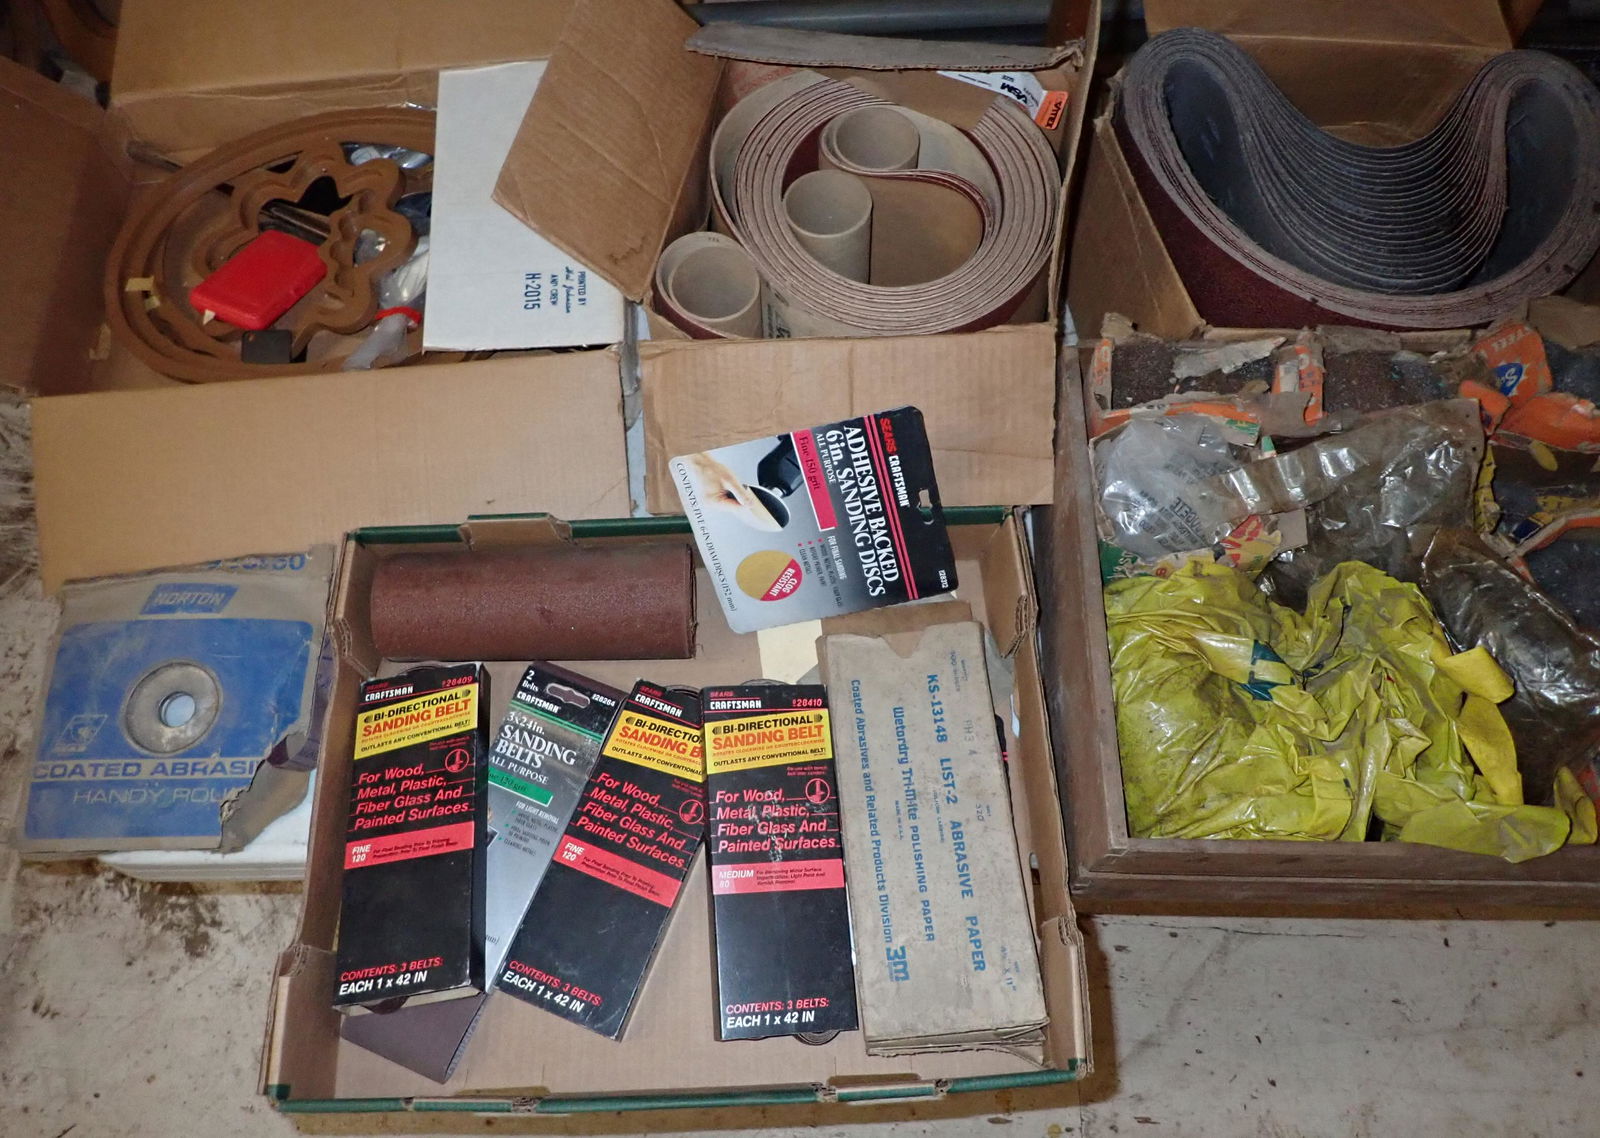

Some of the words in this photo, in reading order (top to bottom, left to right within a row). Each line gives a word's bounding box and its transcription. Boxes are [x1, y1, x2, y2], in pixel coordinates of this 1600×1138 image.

[578, 271, 587, 296] PRINTED
[799, 436, 811, 456] Fine
[815, 433, 827, 448] ALL
[880, 417, 898, 453] SEARS
[805, 458, 817, 475] 150
[820, 449, 837, 484] PURPOSE
[807, 475, 822, 490] grit
[888, 454, 910, 507] CRAFTSMAN
[843, 425, 883, 515] ADHESIVE
[868, 516, 899, 582] BACKED
[836, 466, 870, 547] SANDING
[858, 549, 886, 597] DISCS
[713, 563, 728, 584] DISCS
[769, 567, 796, 597] RESISTANT
[783, 578, 798, 593] CLOG
[153, 591, 226, 606] NORTON
[521, 680, 539, 692] Belts
[526, 669, 535, 680] 2
[365, 686, 414, 702] CRAFTSMAN
[373, 691, 461, 722] BI-DIRECTIONAL
[516, 690, 560, 714] CRAFTSMAN
[634, 693, 683, 718] CRAFTSMAN
[710, 700, 762, 710] CRAFTSMAN
[851, 679, 864, 715] Coated
[361, 708, 433, 738] SANDING
[434, 698, 472, 718] BELT
[722, 715, 813, 735] BI-DIRECTIONAL
[360, 739, 393, 753] OUTLASTS
[393, 736, 406, 745] ANY
[406, 725, 452, 741] CONVENTIONAL
[501, 724, 577, 765] SANDING
[619, 725, 689, 755] SANDING
[712, 730, 788, 752] SANDING
[788, 725, 824, 741] BELT
[856, 717, 870, 770] Abrasives
[495, 738, 545, 769] BELTS
[611, 746, 643, 759] OUTLASTS
[643, 754, 656, 762] ANY
[713, 757, 747, 767] OUTLASTS
[747, 755, 760, 763] ANY
[761, 749, 809, 761] CONVENTIONAL
[33, 761, 142, 780] COATED
[150, 760, 258, 777] ABRASI
[358, 772, 382, 785] For
[385, 763, 425, 781] Wood,
[490, 755, 507, 767] ALL
[507, 762, 550, 785] PURPOSE
[862, 772, 874, 792] and
[73, 788, 166, 805] HANDY
[355, 800, 391, 815] Fiber
[394, 792, 431, 808] Glass
[434, 785, 463, 798] And
[356, 783, 397, 801] Metal,
[400, 775, 447, 793] Plastic,
[596, 772, 621, 788] For
[621, 781, 661, 806] Wood,
[716, 790, 740, 803] For
[743, 788, 785, 803] Wood,
[354, 810, 405, 831] Painted
[407, 802, 470, 822] Surfaces
[590, 787, 628, 812] Metal,
[630, 803, 674, 831] Plastic,
[717, 805, 758, 820] Metal,
[761, 803, 810, 819] Plastic,
[866, 795, 881, 837] Related
[583, 801, 617, 823] Fiber
[619, 816, 656, 839] Glass
[656, 831, 686, 850] And
[717, 822, 754, 837] Fiber
[757, 821, 796, 836] Glass
[799, 818, 828, 832] And
[893, 706, 911, 765] Wetordry
[910, 825, 928, 894] POLISHING
[921, 899, 935, 942] PAPER
[926, 673, 948, 743] KS-13148
[939, 757, 959, 805] LIST-2
[950, 820, 974, 900] ABRASIVE
[965, 915, 987, 973] PAPER
[352, 844, 372, 855] FINE
[564, 842, 585, 855] FINE
[576, 816, 625, 844] Painted
[626, 836, 685, 868] Surfaces
[718, 837, 771, 853] Painted
[774, 836, 836, 851] Surfaces
[352, 854, 367, 863] 120
[562, 851, 577, 861] 120
[868, 838, 887, 892] Products
[719, 869, 754, 879] MEDIUM
[879, 894, 893, 944] Division
[340, 964, 398, 983] CONTENTS:
[400, 962, 408, 973] 3
[409, 957, 444, 970] BELTS:
[339, 980, 373, 996] EACH
[376, 977, 383, 989] 1
[386, 979, 393, 988] x
[396, 974, 412, 986] 42
[413, 970, 428, 983] IN
[502, 971, 536, 992] EACH
[538, 985, 545, 996] 1
[544, 991, 553, 1000] x
[553, 993, 570, 1007] 42
[569, 999, 585, 1013] IN
[509, 960, 561, 989] CONTENTS:
[562, 983, 570, 993] 3
[571, 987, 602, 1007] BELTS:
[725, 1001, 785, 1014] CONTENTS:
[787, 1001, 793, 1010] 3
[795, 997, 830, 1009] BELTS:
[726, 1014, 761, 1028] EACH
[764, 1015, 770, 1025] 1
[773, 1016, 781, 1025] x
[784, 1012, 799, 1024] 42
[802, 1010, 815, 1023] IN
